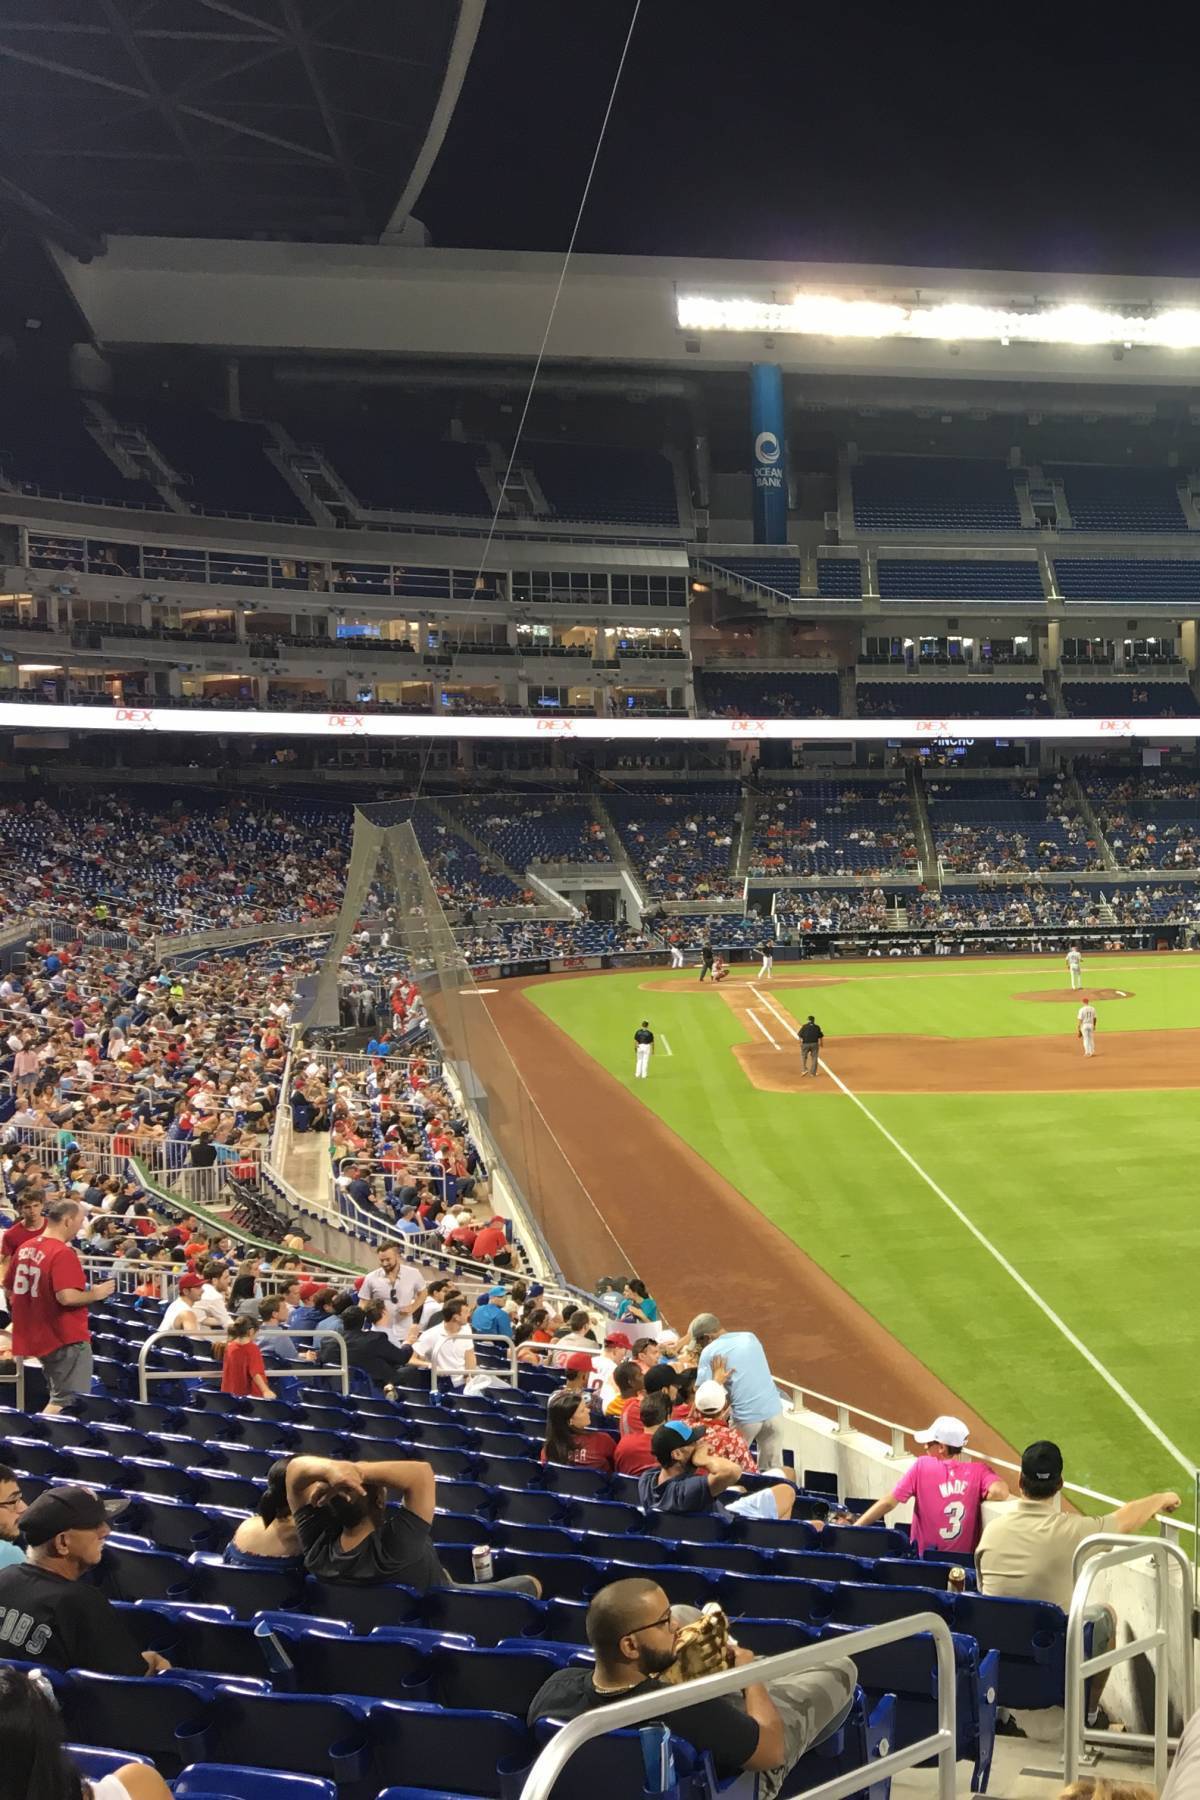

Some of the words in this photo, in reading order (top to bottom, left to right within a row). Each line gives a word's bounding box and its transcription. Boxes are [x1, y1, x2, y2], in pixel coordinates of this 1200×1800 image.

[754, 467, 782, 478] OCEAN
[756, 478, 781, 487] BANK
[116, 709, 153, 721] DEX
[328, 715, 364, 727] DEX
[537, 719, 573, 730] DEX
[731, 720, 766, 731] DEX
[916, 721, 949, 731] DEX
[1100, 720, 1132, 730] DEX
[13, 1263, 41, 1298] 67
[938, 1479, 968, 1498] WADE
[939, 1501, 966, 1540] 3
